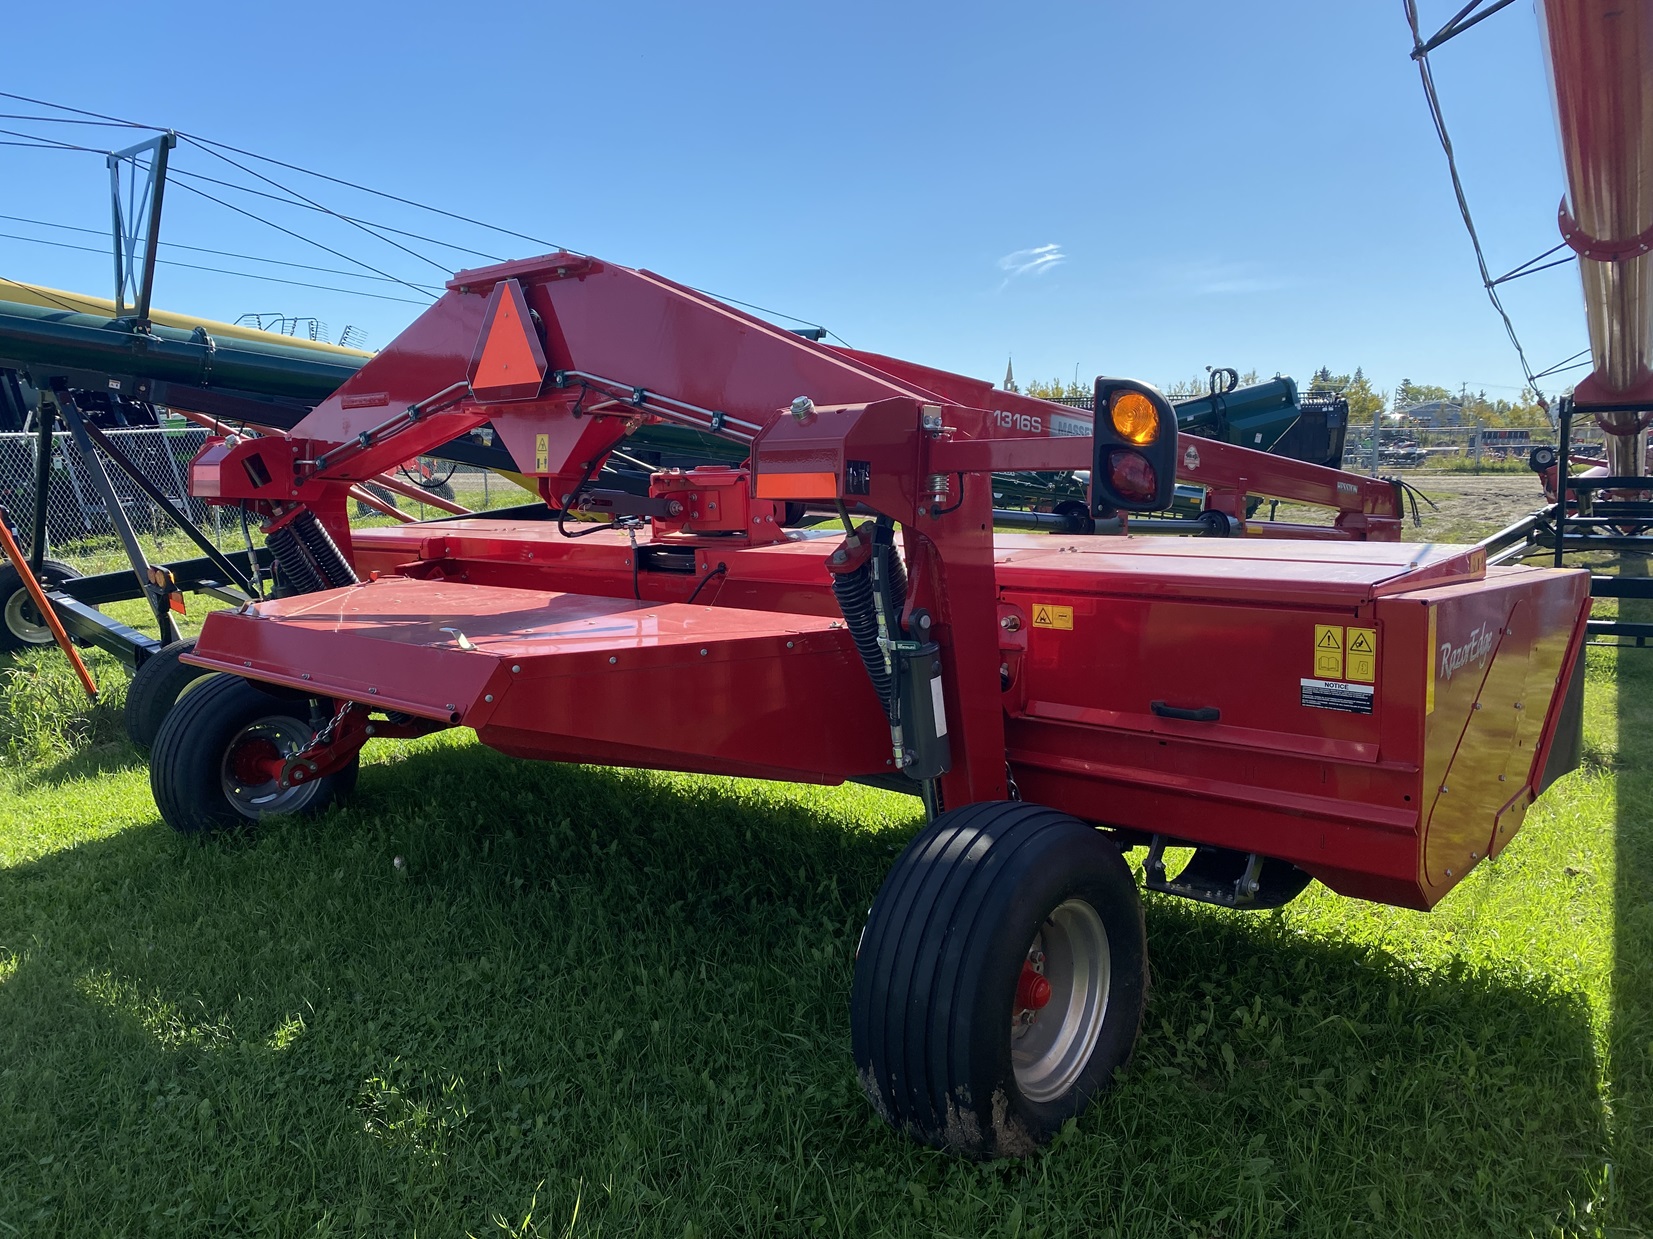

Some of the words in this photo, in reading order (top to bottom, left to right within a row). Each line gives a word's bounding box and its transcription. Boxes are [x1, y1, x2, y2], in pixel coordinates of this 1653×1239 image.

[994, 410, 1042, 433] 1316S
[1440, 621, 1492, 680] RazorEdge
[1324, 682, 1348, 690] NOTICE
